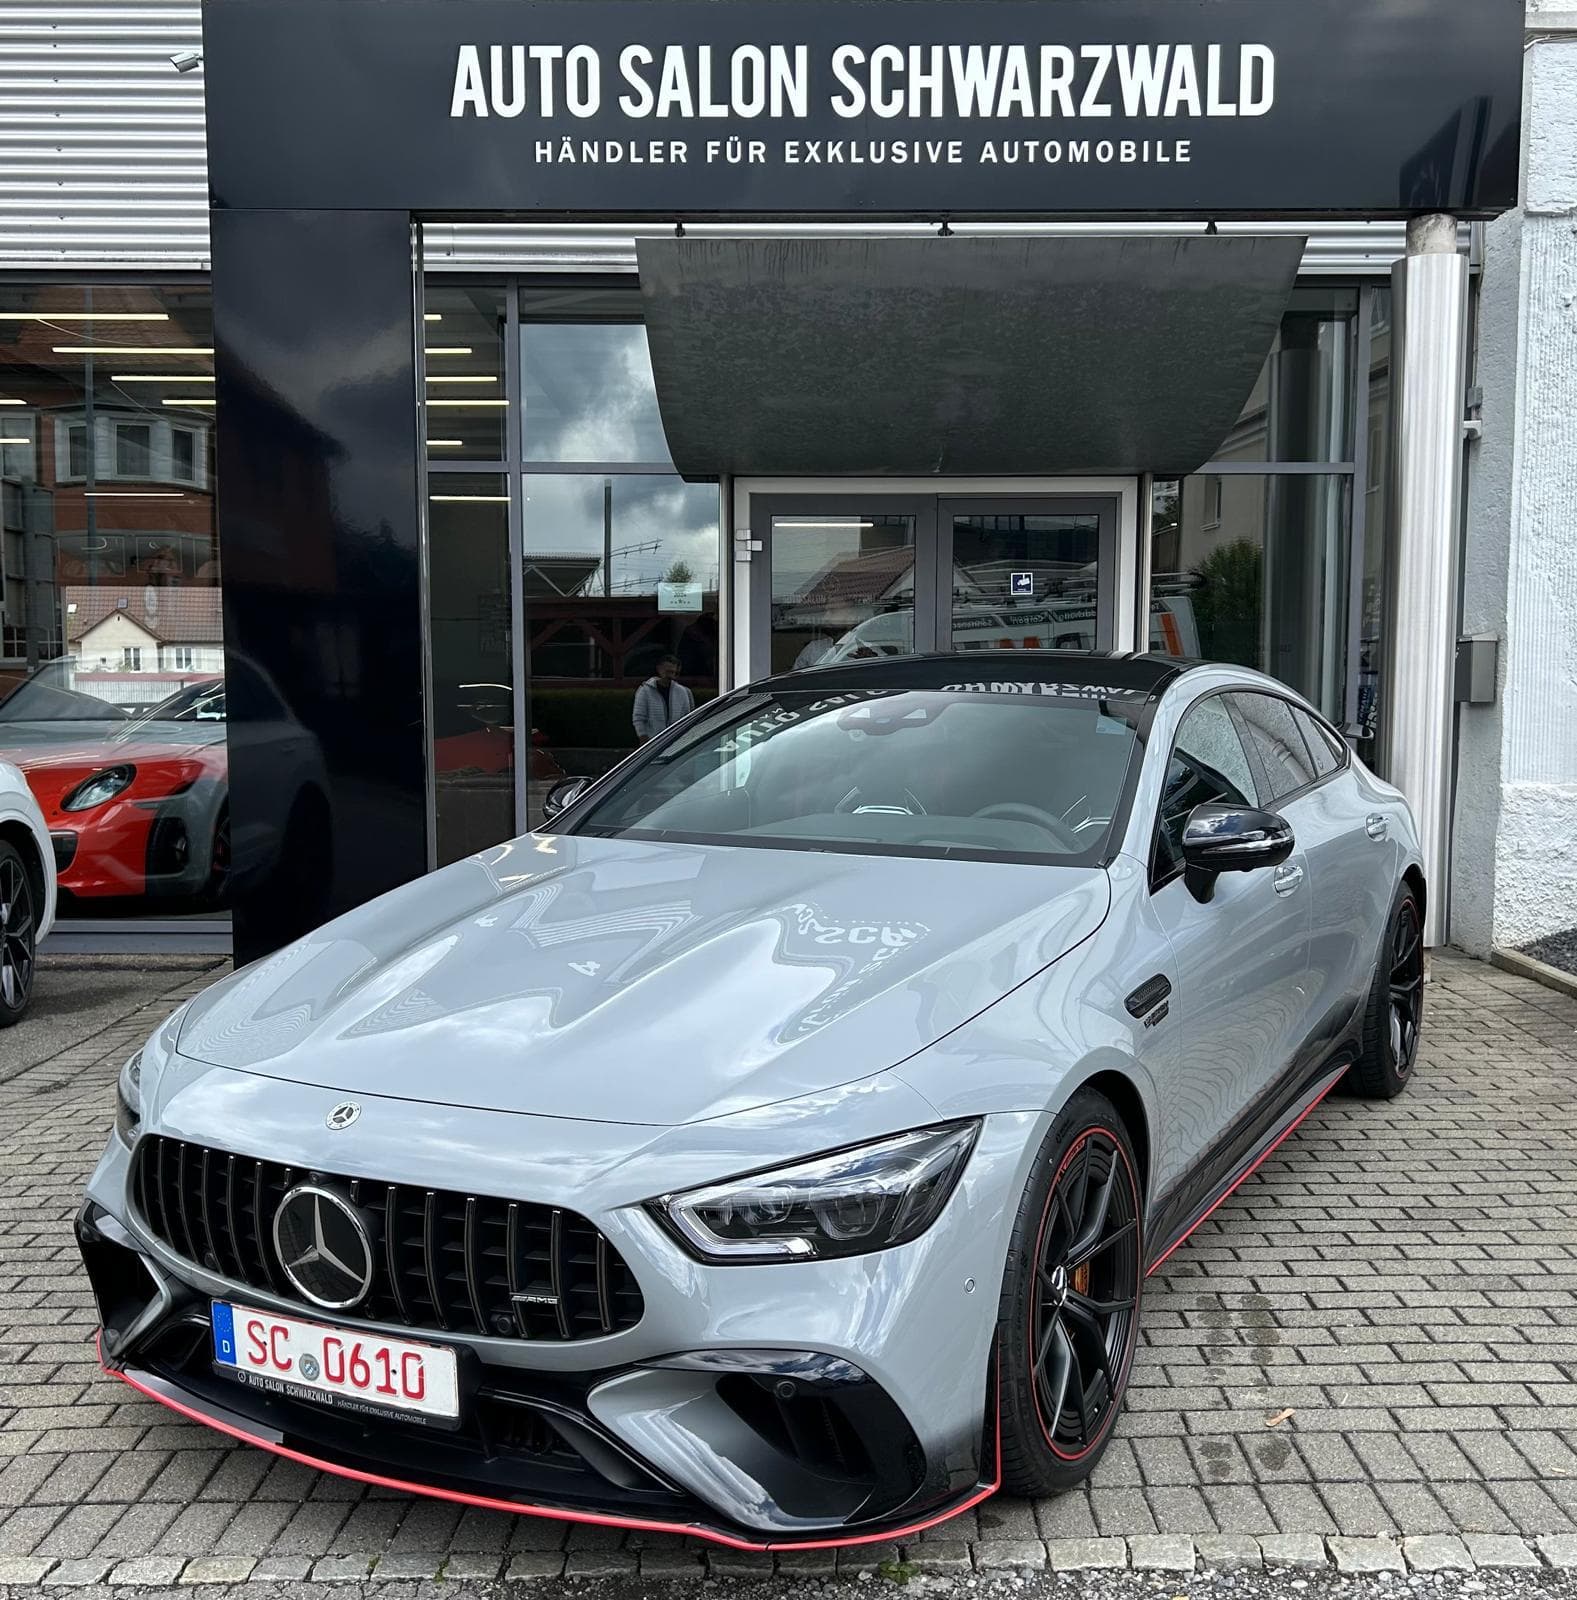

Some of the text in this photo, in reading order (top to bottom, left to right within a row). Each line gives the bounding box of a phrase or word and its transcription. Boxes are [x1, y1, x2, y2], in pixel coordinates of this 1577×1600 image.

[450, 43, 1275, 119] AUTO SALON SCHWARZWALD
[535, 135, 1191, 164] HÄNDLER FÜR EXKLUSIVE AUTOMOBILE
[222, 1339, 230, 1354] D
[247, 1319, 425, 1400] SC 0610
[249, 1375, 333, 1405] AUTO SALON SCHWARZWALD
